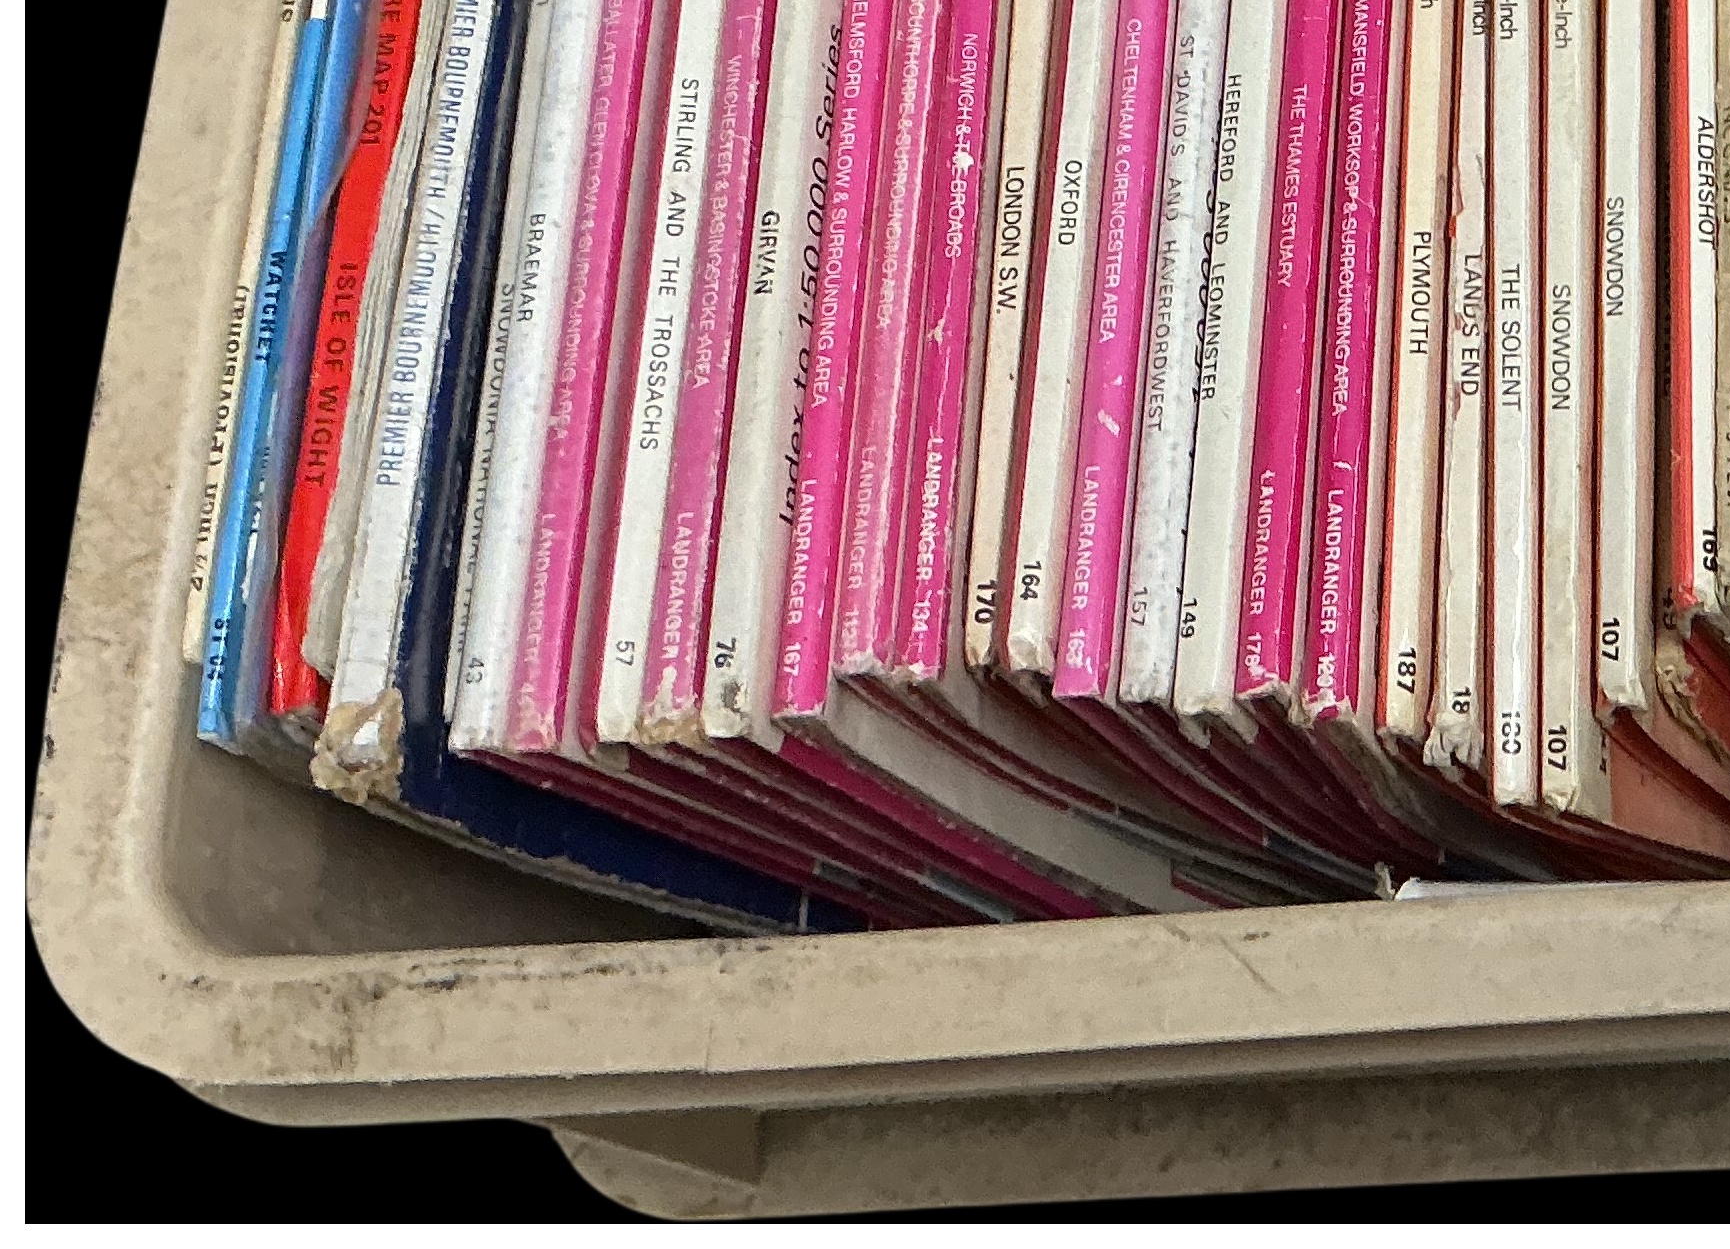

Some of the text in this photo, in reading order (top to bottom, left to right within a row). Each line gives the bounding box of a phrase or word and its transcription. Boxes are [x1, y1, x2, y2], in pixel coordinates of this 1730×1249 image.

[371, 33, 398, 103] MAP
[362, 106, 384, 147] 201
[837, 108, 862, 187] HARLOW
[832, 191, 849, 204] &
[1058, 159, 1082, 246] OXFORD
[1099, 19, 1143, 344] CHELTENHAM & CIRENCESTER AREA
[1278, 83, 1306, 286] THE THAMES ESTUARY
[639, 79, 700, 451] STIRLING AND THE TROSSACHS
[752, 211, 781, 296] GIRVAN
[817, 208, 847, 351] SURROUNDING
[996, 166, 1025, 313] LONDON S.W.
[1410, 231, 1432, 355] PLYMOUTH
[306, 263, 358, 488] ISLE OF WIGHT
[811, 353, 833, 408] AREA
[1502, 263, 1521, 411] THE SOLENT
[1552, 283, 1570, 411] SNOWDON
[781, 479, 819, 676] LANDRANGER 167
[1020, 561, 1042, 599] 164
[1071, 466, 1099, 610] LANDRANGER
[974, 580, 998, 623] 170
[615, 641, 635, 667] 57
[1396, 649, 1416, 695] 187
[1546, 725, 1566, 771] 107
